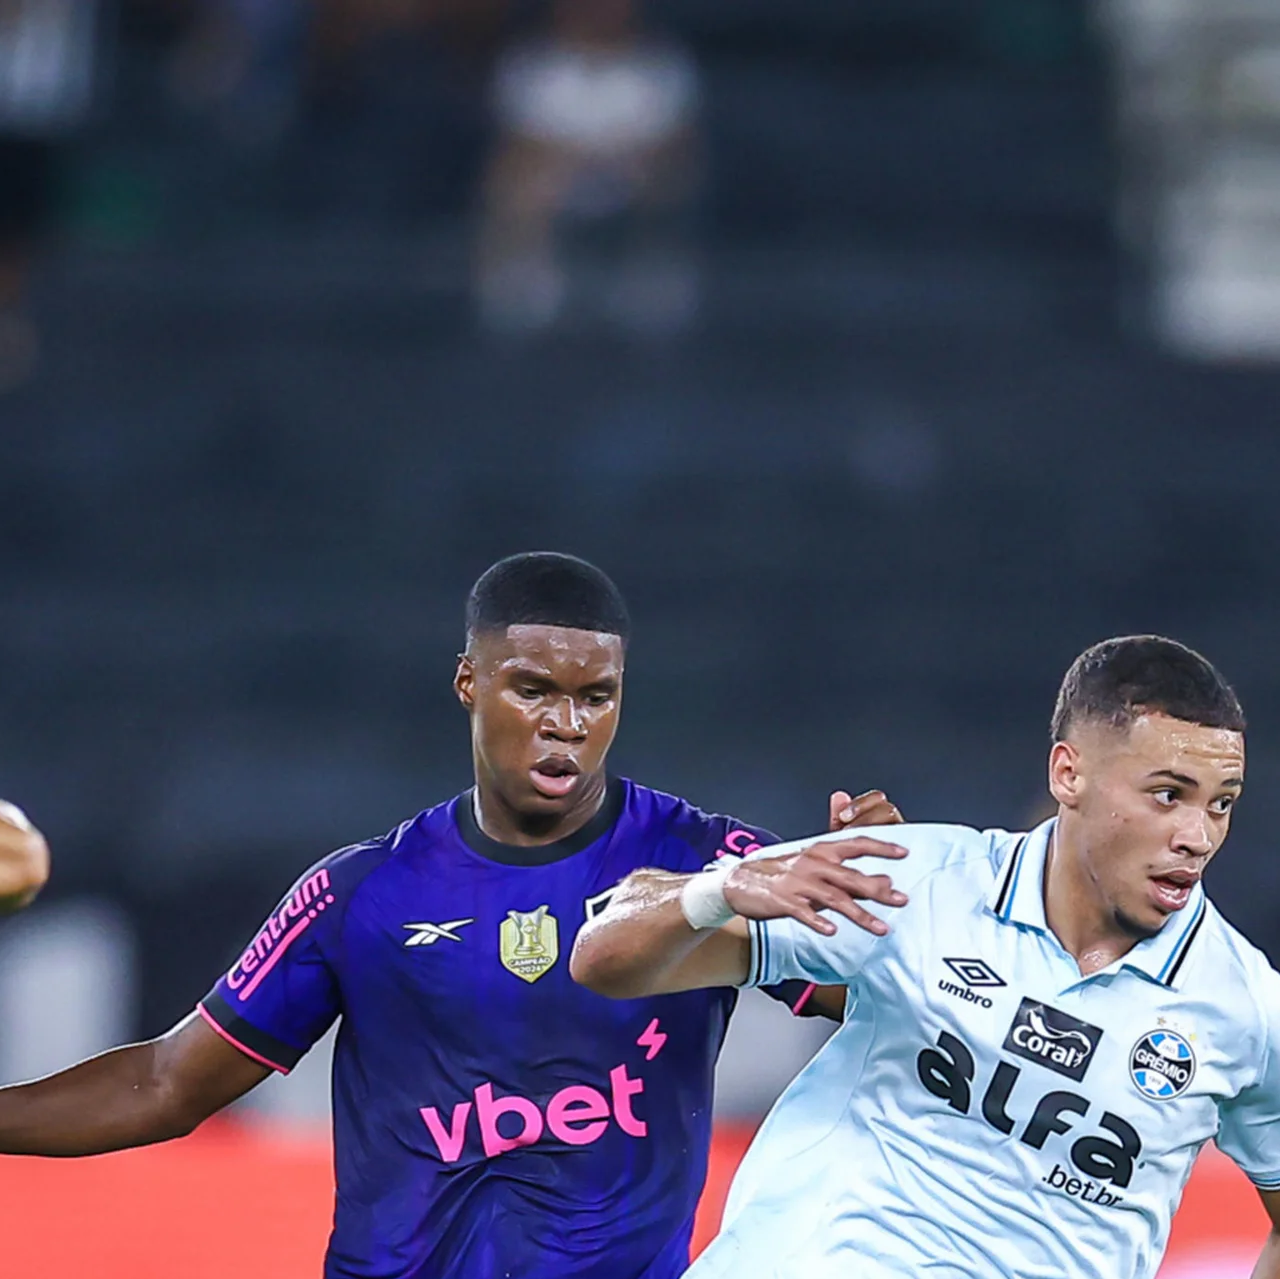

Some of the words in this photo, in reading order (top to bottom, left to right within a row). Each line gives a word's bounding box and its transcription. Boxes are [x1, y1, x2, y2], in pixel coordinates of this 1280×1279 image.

[226, 868, 330, 989] centrum
[937, 979, 993, 1009] umbro
[1012, 1025, 1078, 1067] Coral
[1135, 1048, 1188, 1083] GRÊMIO
[420, 1064, 647, 1163] vbet
[917, 1030, 1143, 1188] alfa
